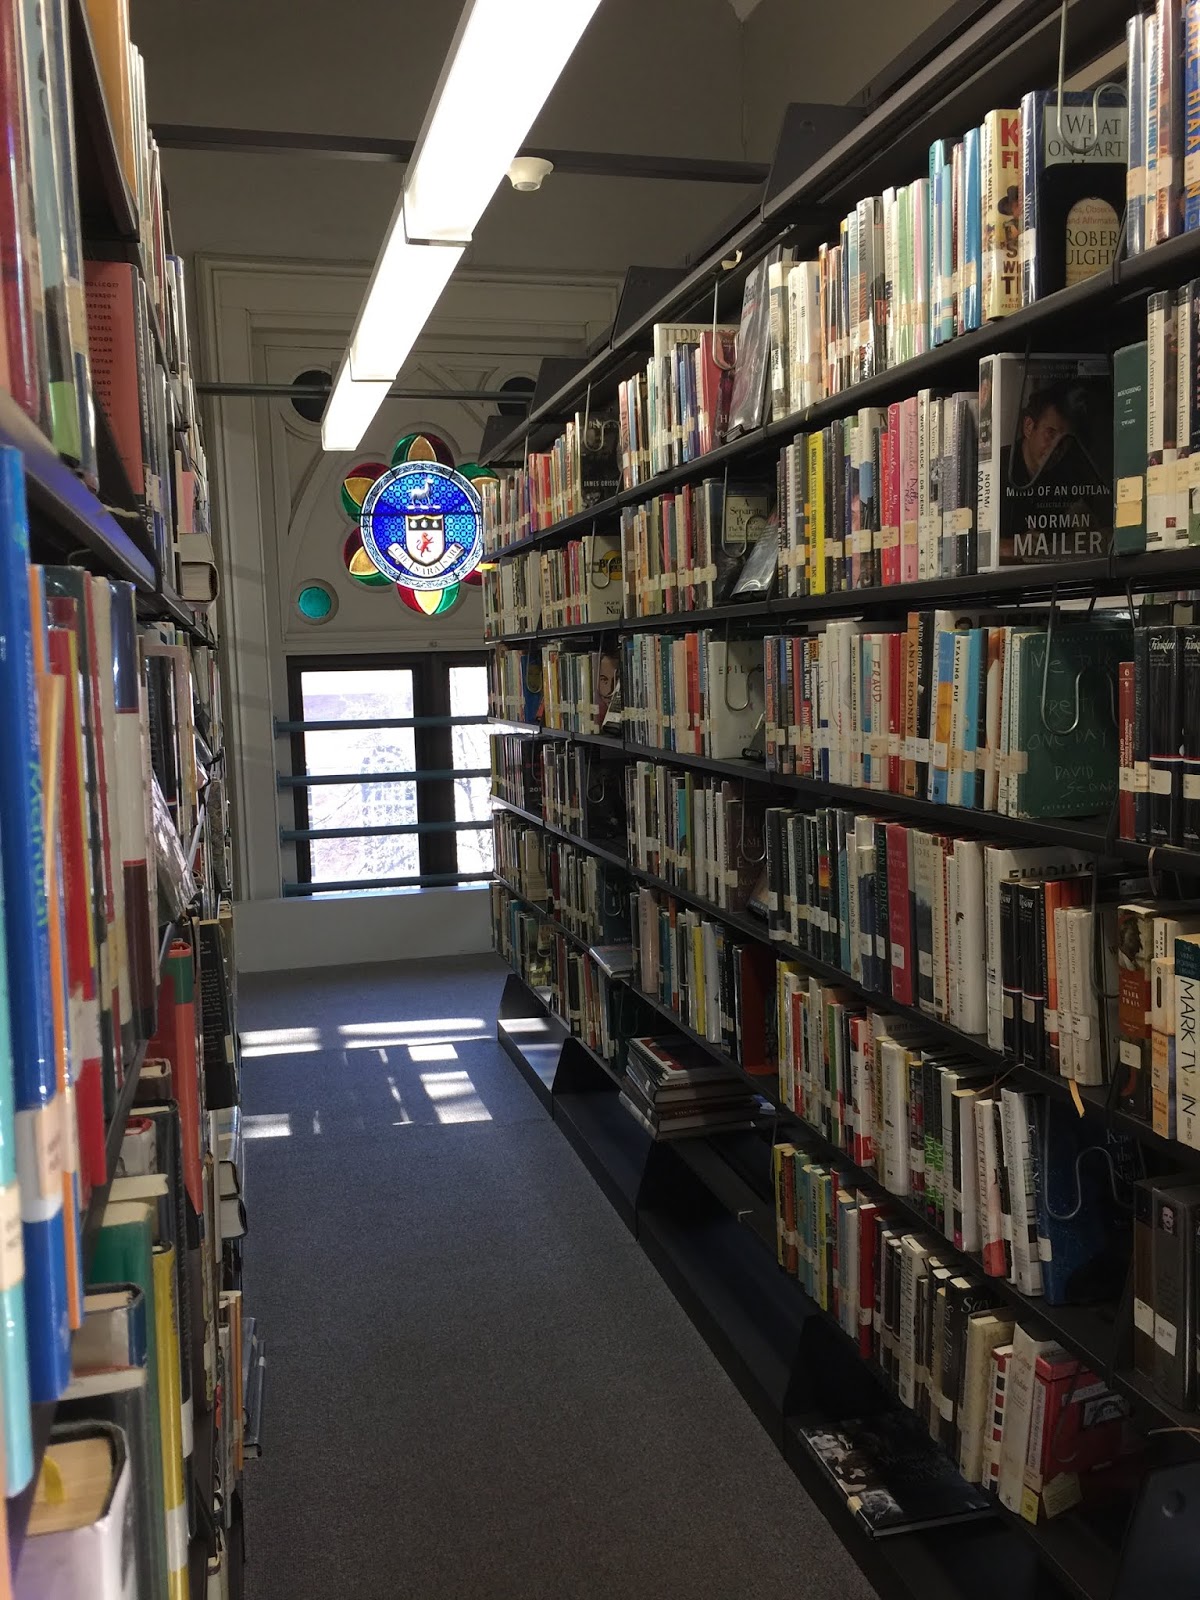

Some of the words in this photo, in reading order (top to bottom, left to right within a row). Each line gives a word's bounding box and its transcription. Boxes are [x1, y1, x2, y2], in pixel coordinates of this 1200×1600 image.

[1065, 114, 1121, 135] WHAT
[1082, 136, 1126, 157] EART
[1187, 88, 1200, 199] HIAAN
[1065, 229, 1118, 247] ROBER
[1065, 249, 1115, 266] ULGH
[1149, 317, 1158, 351] African
[1179, 310, 1187, 348] African
[1149, 357, 1158, 407] American
[1179, 352, 1187, 401] American
[1149, 411, 1158, 447] Humor
[1179, 404, 1187, 442] Humor
[919, 435, 925, 447] WE
[600, 479, 620, 487] GRISSO
[1006, 486, 1034, 498] MIND
[1037, 486, 1051, 497] OF
[1054, 485, 1068, 496] AN
[1072, 485, 1111, 496] OUTLAW
[729, 506, 763, 518] Separate
[1025, 513, 1091, 529] NORMAN
[1013, 530, 1102, 557] MAILER
[413, 565, 440, 576] SARA
[785, 640, 793, 671] McMANUS
[803, 642, 811, 672] MICHAEL
[907, 640, 915, 677] ANDY
[953, 640, 961, 680] STAYING
[803, 673, 811, 699] MOORE
[871, 660, 882, 702] FRAUD
[952, 684, 960, 703] PUT
[906, 680, 915, 734] ROONEY
[1075, 728, 1107, 747] DAY
[802, 747, 811, 768] THIS!
[1054, 765, 1094, 781] DAVID
[877, 832, 887, 865] JOHN
[878, 871, 888, 920] UPDIKE
[1069, 920, 1077, 944] Oprah
[1070, 945, 1078, 974] Winfrey
[1122, 989, 1139, 999] MARK
[1122, 997, 1140, 1007] TWAIN
[1180, 979, 1196, 1044] MARK
[1180, 1049, 1196, 1116] TWIN
[978, 1126, 986, 1145] THE
[1005, 1121, 1016, 1186] LANCASTER
[979, 1150, 988, 1198] EMPATHY
[944, 1304, 954, 1321] Say
